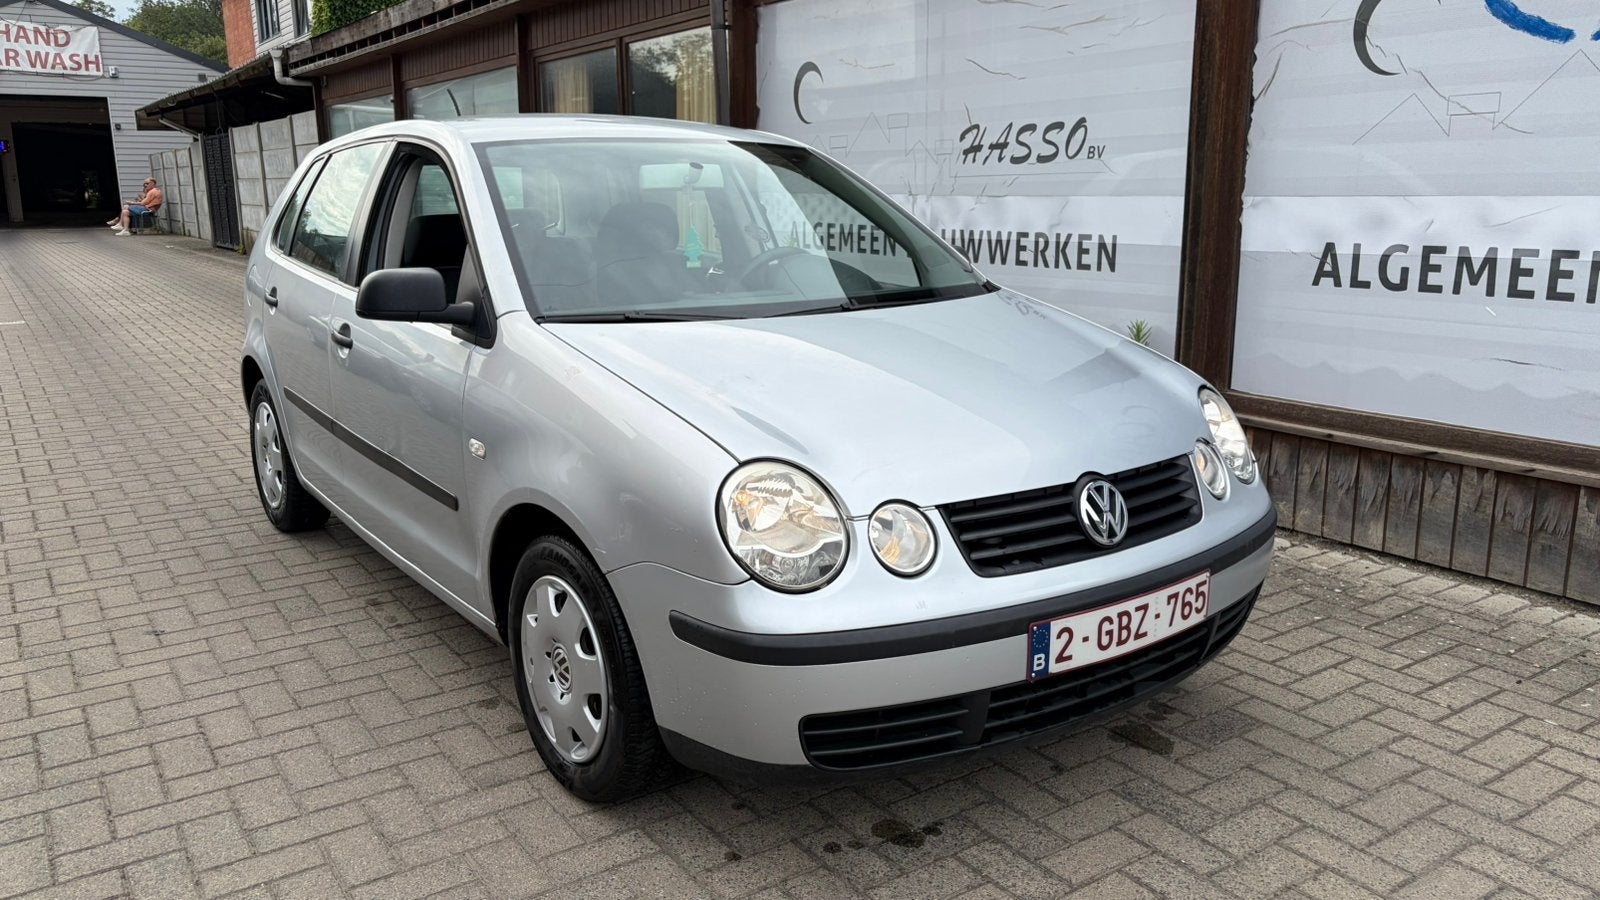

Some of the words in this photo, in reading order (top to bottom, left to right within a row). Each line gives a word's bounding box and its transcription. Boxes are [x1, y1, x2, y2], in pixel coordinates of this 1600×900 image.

[0, 23, 71, 48] HAND
[0, 48, 21, 68] R
[25, 49, 101, 73] WASH
[959, 116, 1088, 166] HASSO
[1087, 144, 1106, 160] BV
[790, 220, 897, 257] ALGEMEEN
[1033, 653, 1046, 671] B
